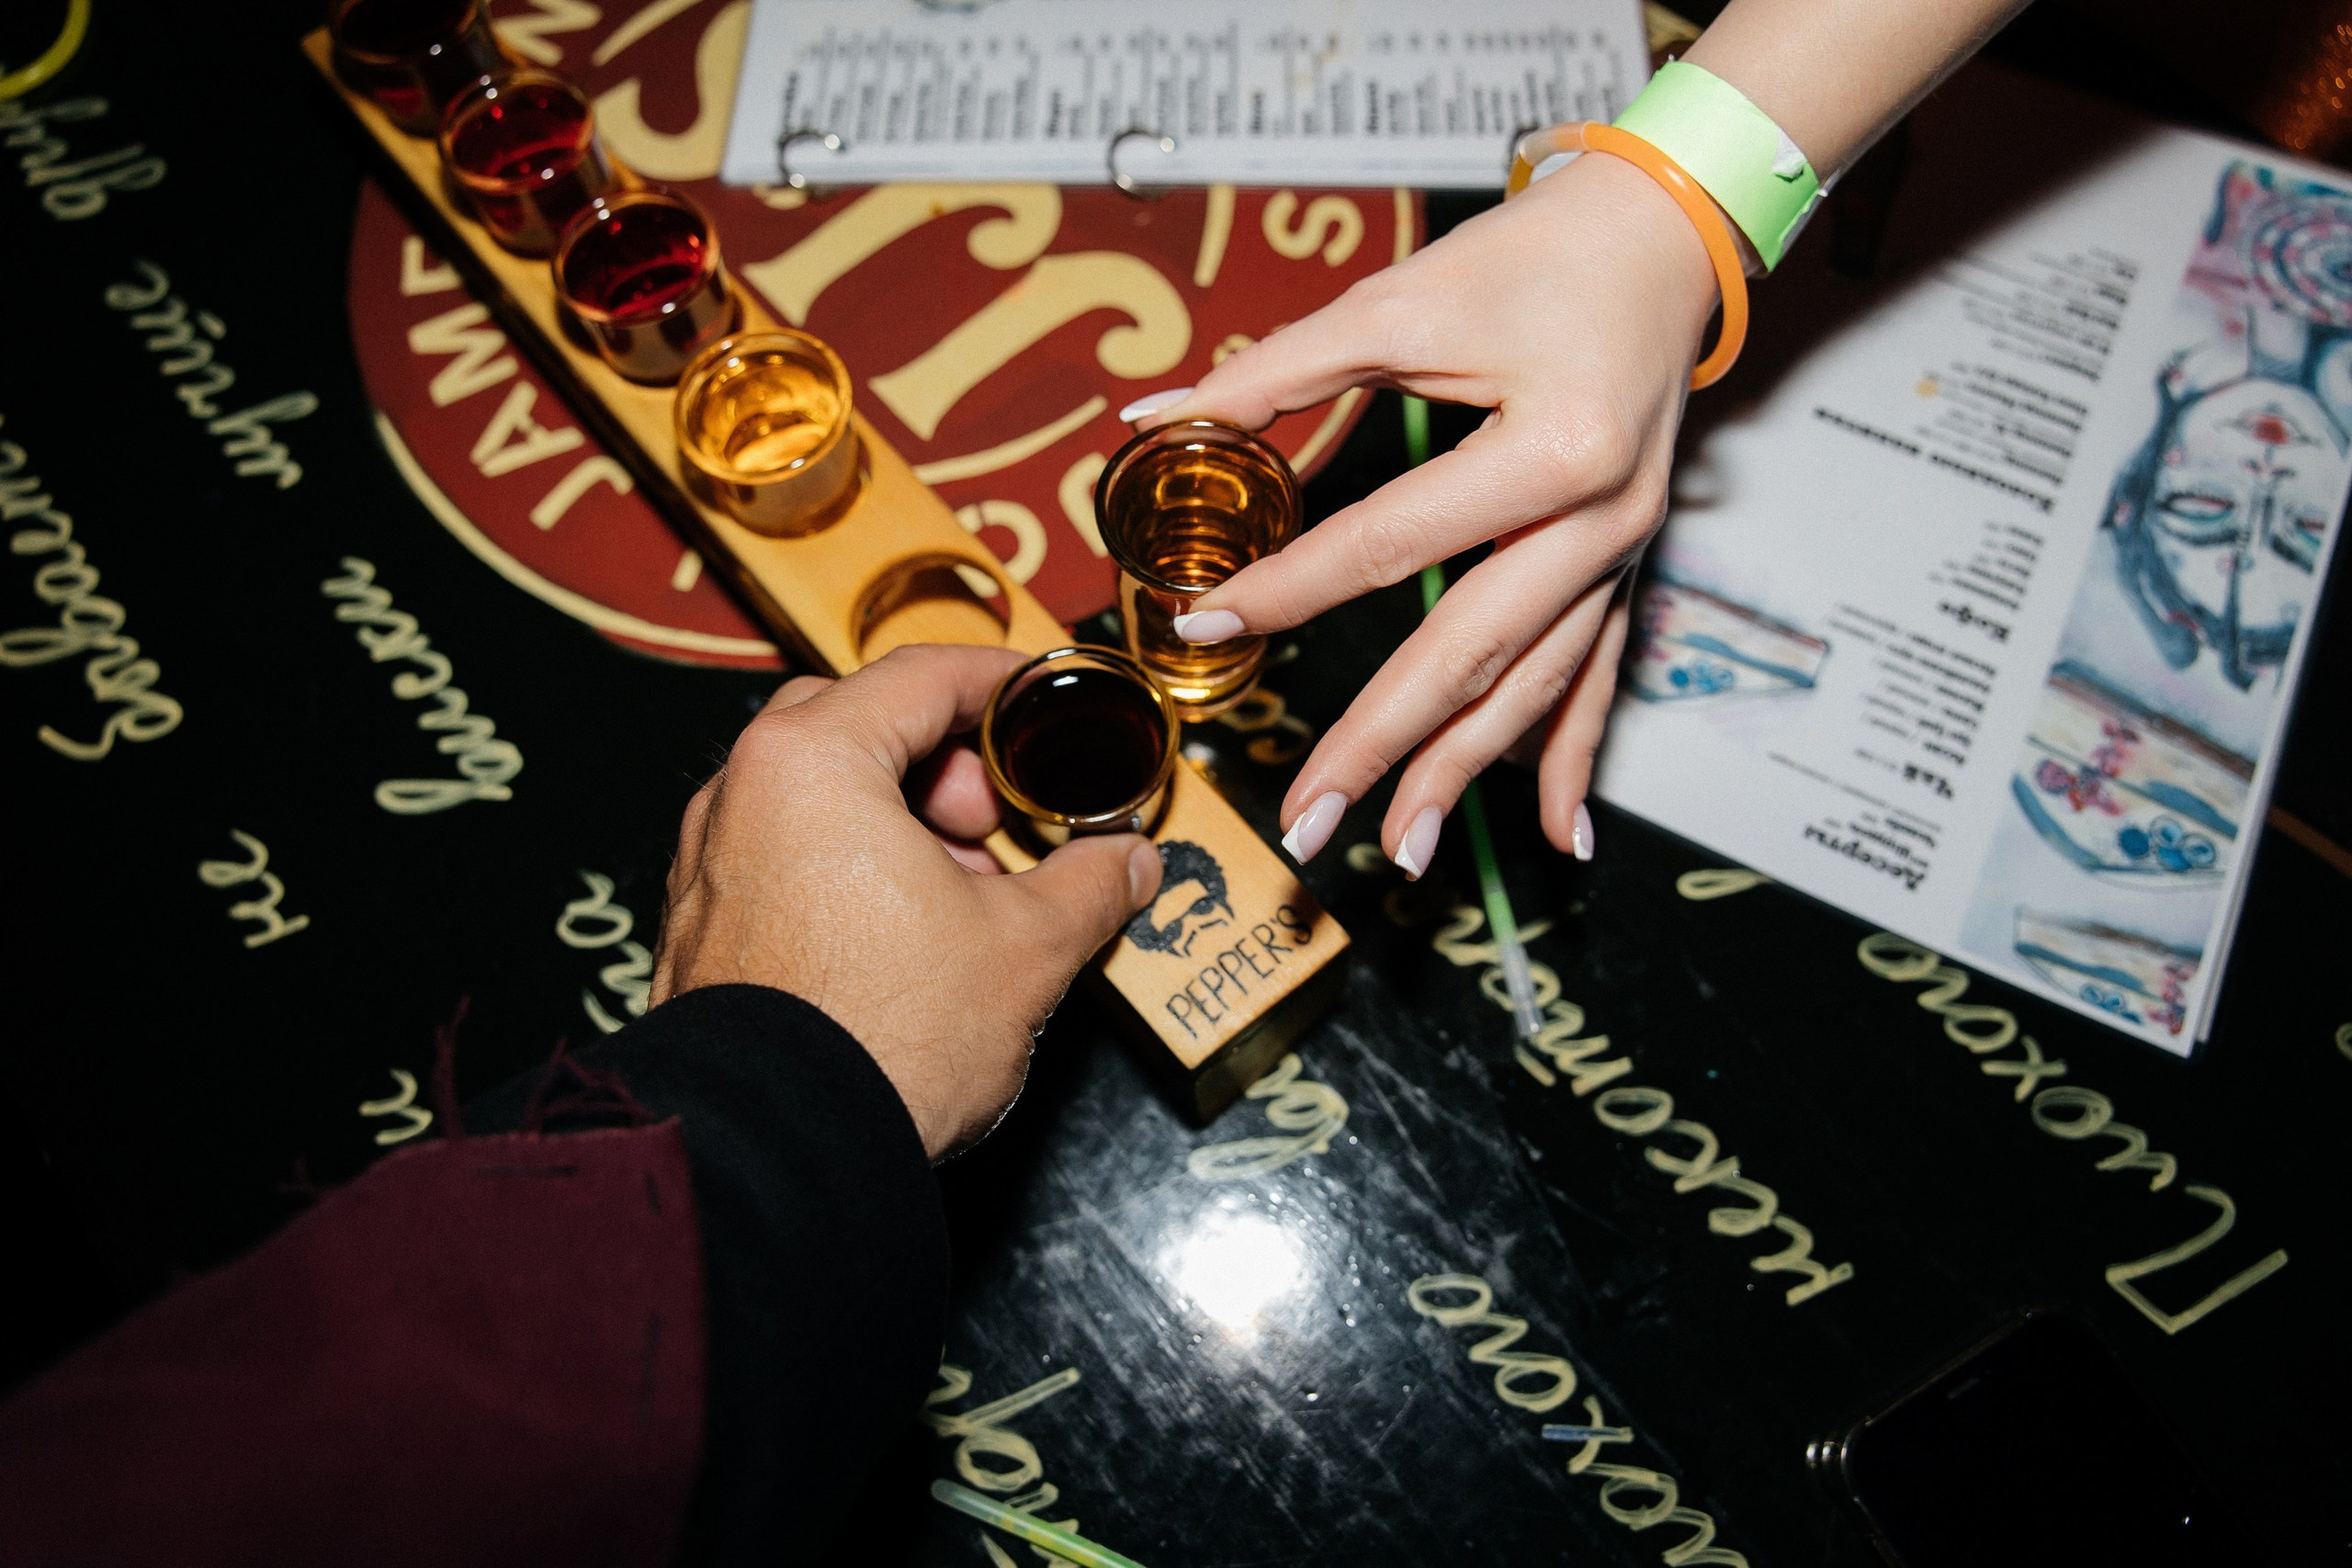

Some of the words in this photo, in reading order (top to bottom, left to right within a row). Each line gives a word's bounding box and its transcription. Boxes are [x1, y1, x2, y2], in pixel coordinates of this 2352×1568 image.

[319, 554, 526, 817] виски
[1803, 825, 1926, 891] Десерты
[1166, 903, 1314, 1040] PEPPER'S
[1856, 931, 2290, 1337] Плохого
